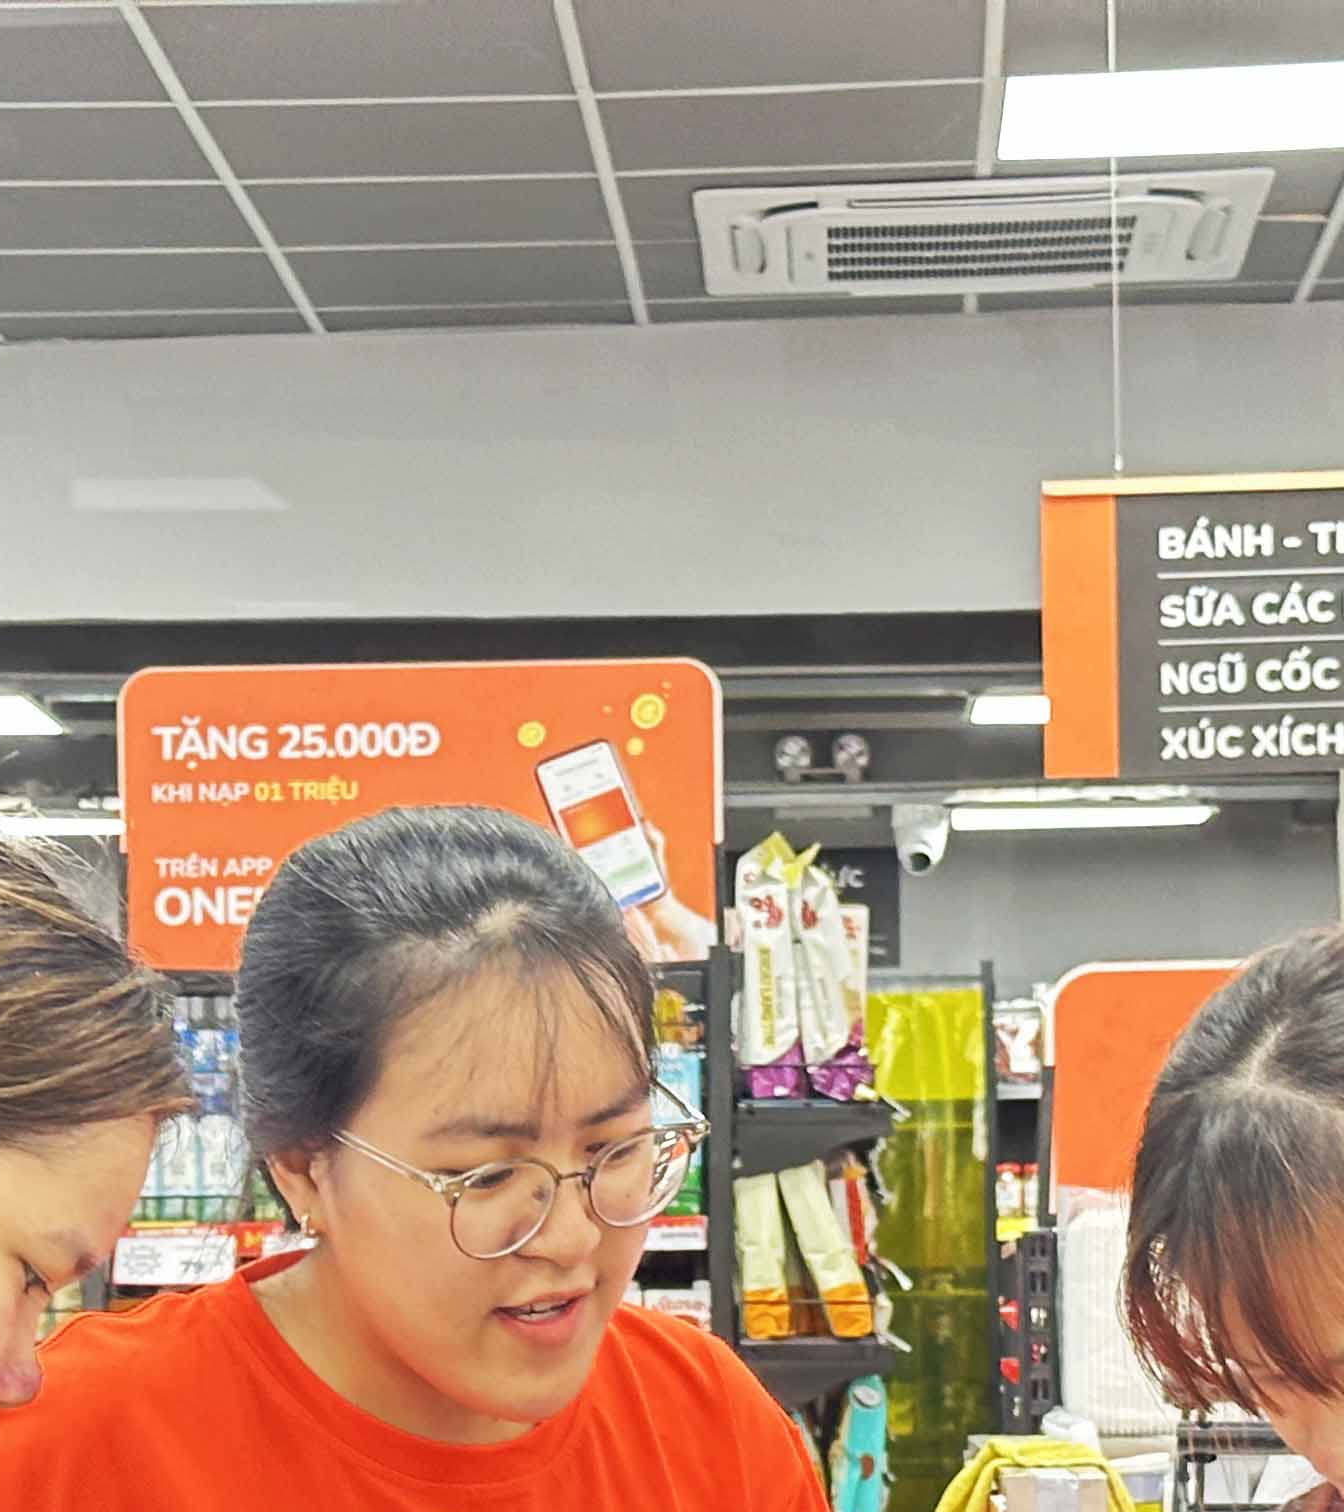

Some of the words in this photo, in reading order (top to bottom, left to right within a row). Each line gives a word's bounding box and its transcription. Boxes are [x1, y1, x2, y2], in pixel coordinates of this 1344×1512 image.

[1158, 517, 1273, 560] BÁNH
[1159, 584, 1245, 629] SỮA
[1253, 582, 1335, 626] CÁC
[1160, 655, 1246, 696] NGŨ
[1255, 646, 1341, 691] CỐC
[150, 715, 269, 770] TẶNG
[277, 721, 441, 759] 25.000Đ
[1160, 717, 1244, 761] XÚC
[151, 782, 193, 803] KHI
[198, 782, 250, 806] NẠP
[254, 782, 284, 801] 01
[288, 775, 359, 805] TRIỆU
[154, 851, 219, 879] TRÊN
[222, 856, 273, 878] APP
